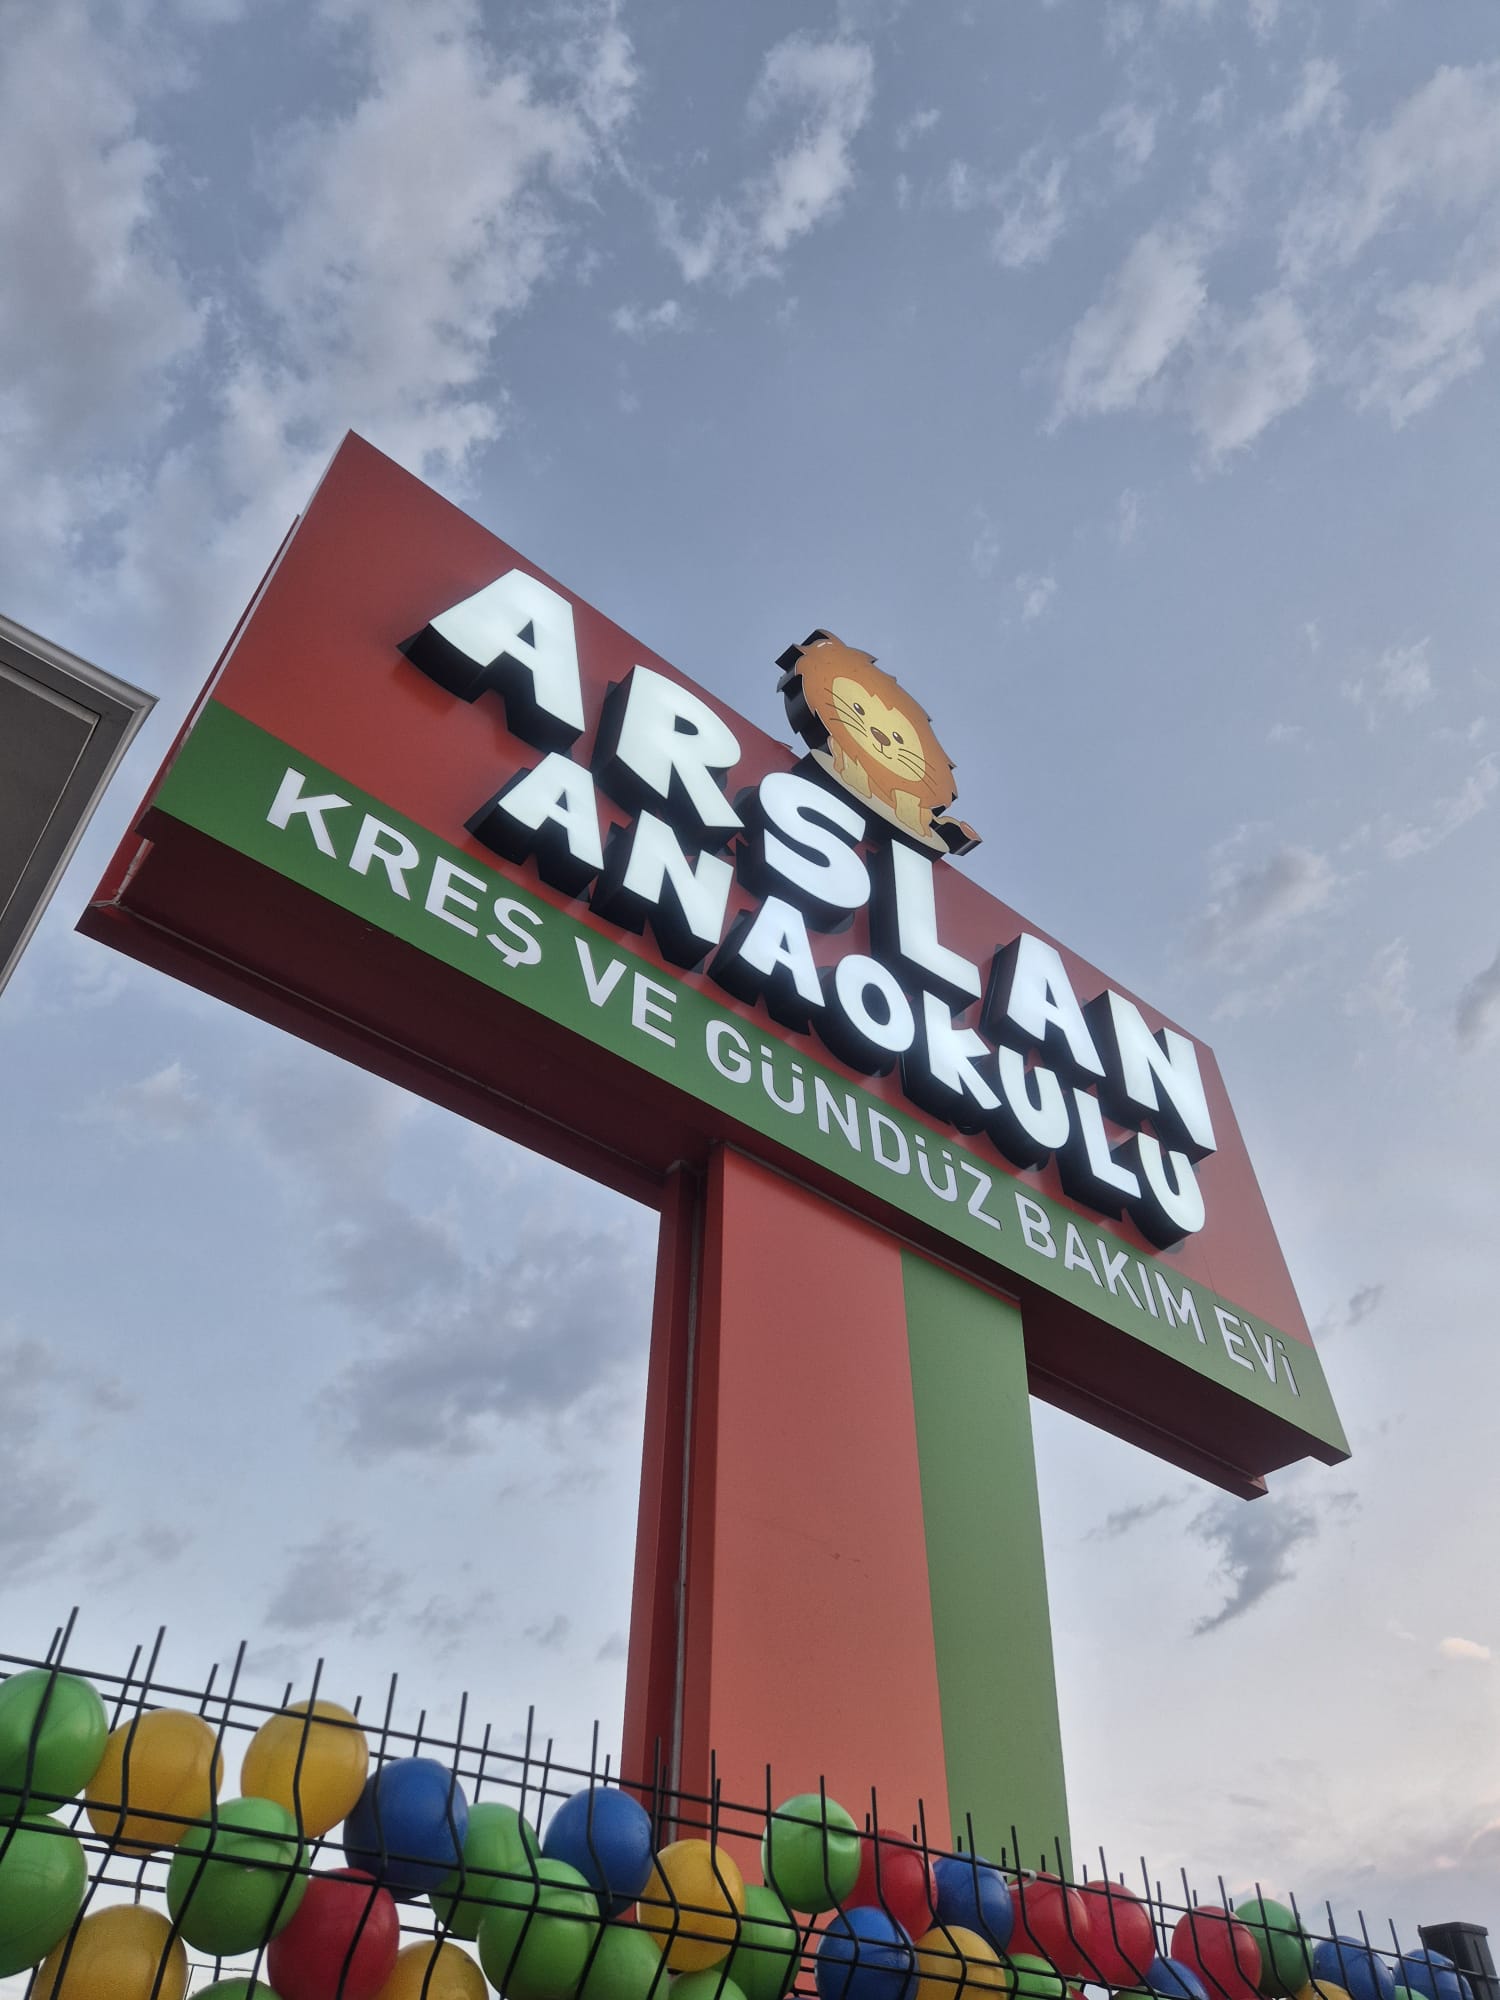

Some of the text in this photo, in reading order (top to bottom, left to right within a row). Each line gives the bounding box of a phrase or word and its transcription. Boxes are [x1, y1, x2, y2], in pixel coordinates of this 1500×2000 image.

[265, 766, 544, 968] KREŞ
[572, 938, 677, 1049] VE
[705, 1019, 1001, 1230] GÜNDÜZ
[1014, 1192, 1207, 1345] BAKIM
[429, 568, 1217, 1152] ARSLAN
[497, 751, 1206, 1234] ANAOKULU
